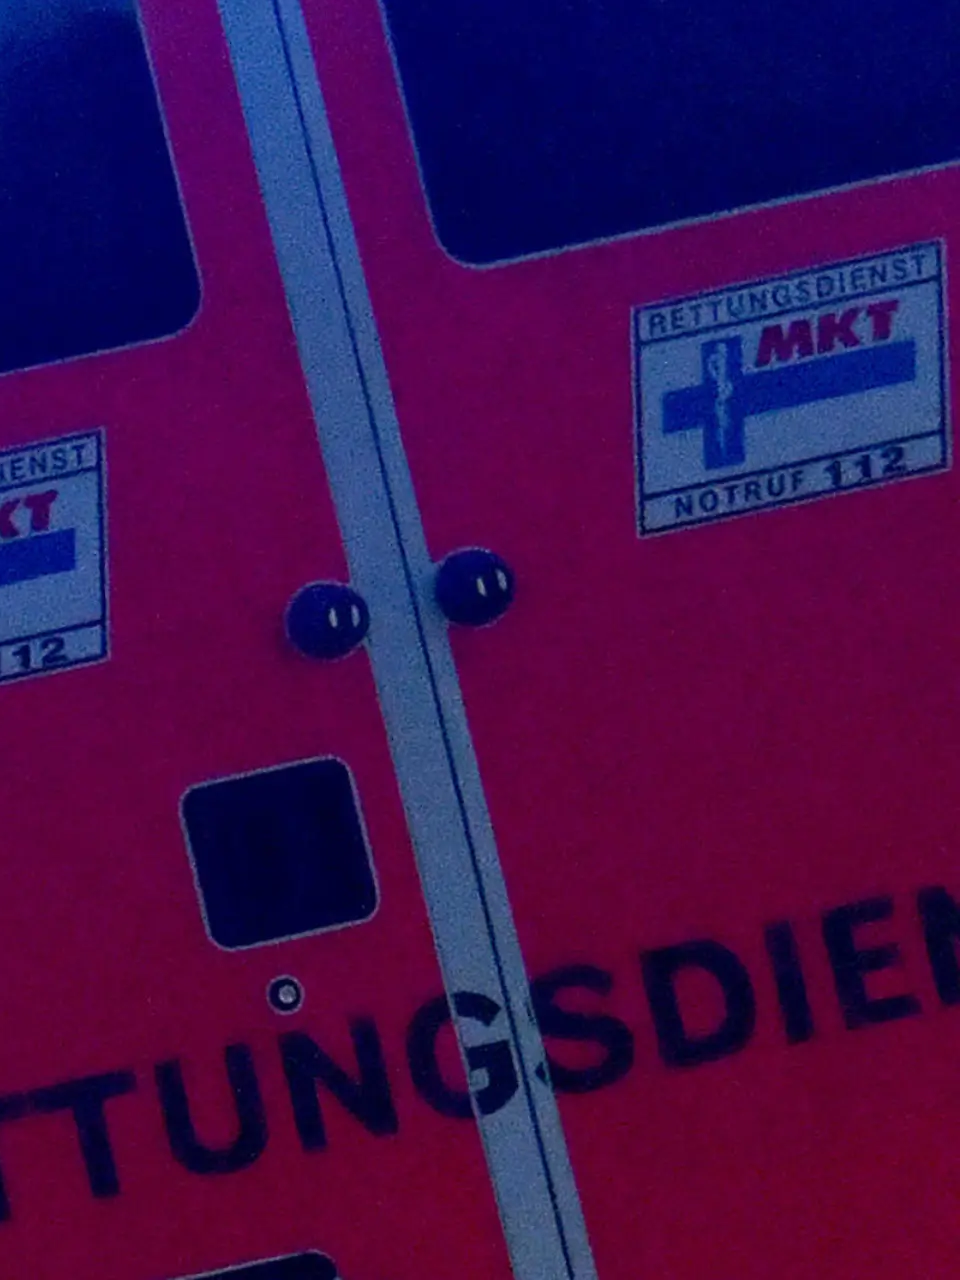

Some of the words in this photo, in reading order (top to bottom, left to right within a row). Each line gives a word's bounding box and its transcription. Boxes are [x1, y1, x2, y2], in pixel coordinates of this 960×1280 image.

[648, 254, 927, 335] RETTUNGSDIENST
[755, 299, 899, 368] MKT
[674, 471, 806, 518] NOTRUF
[823, 446, 907, 488] 112
